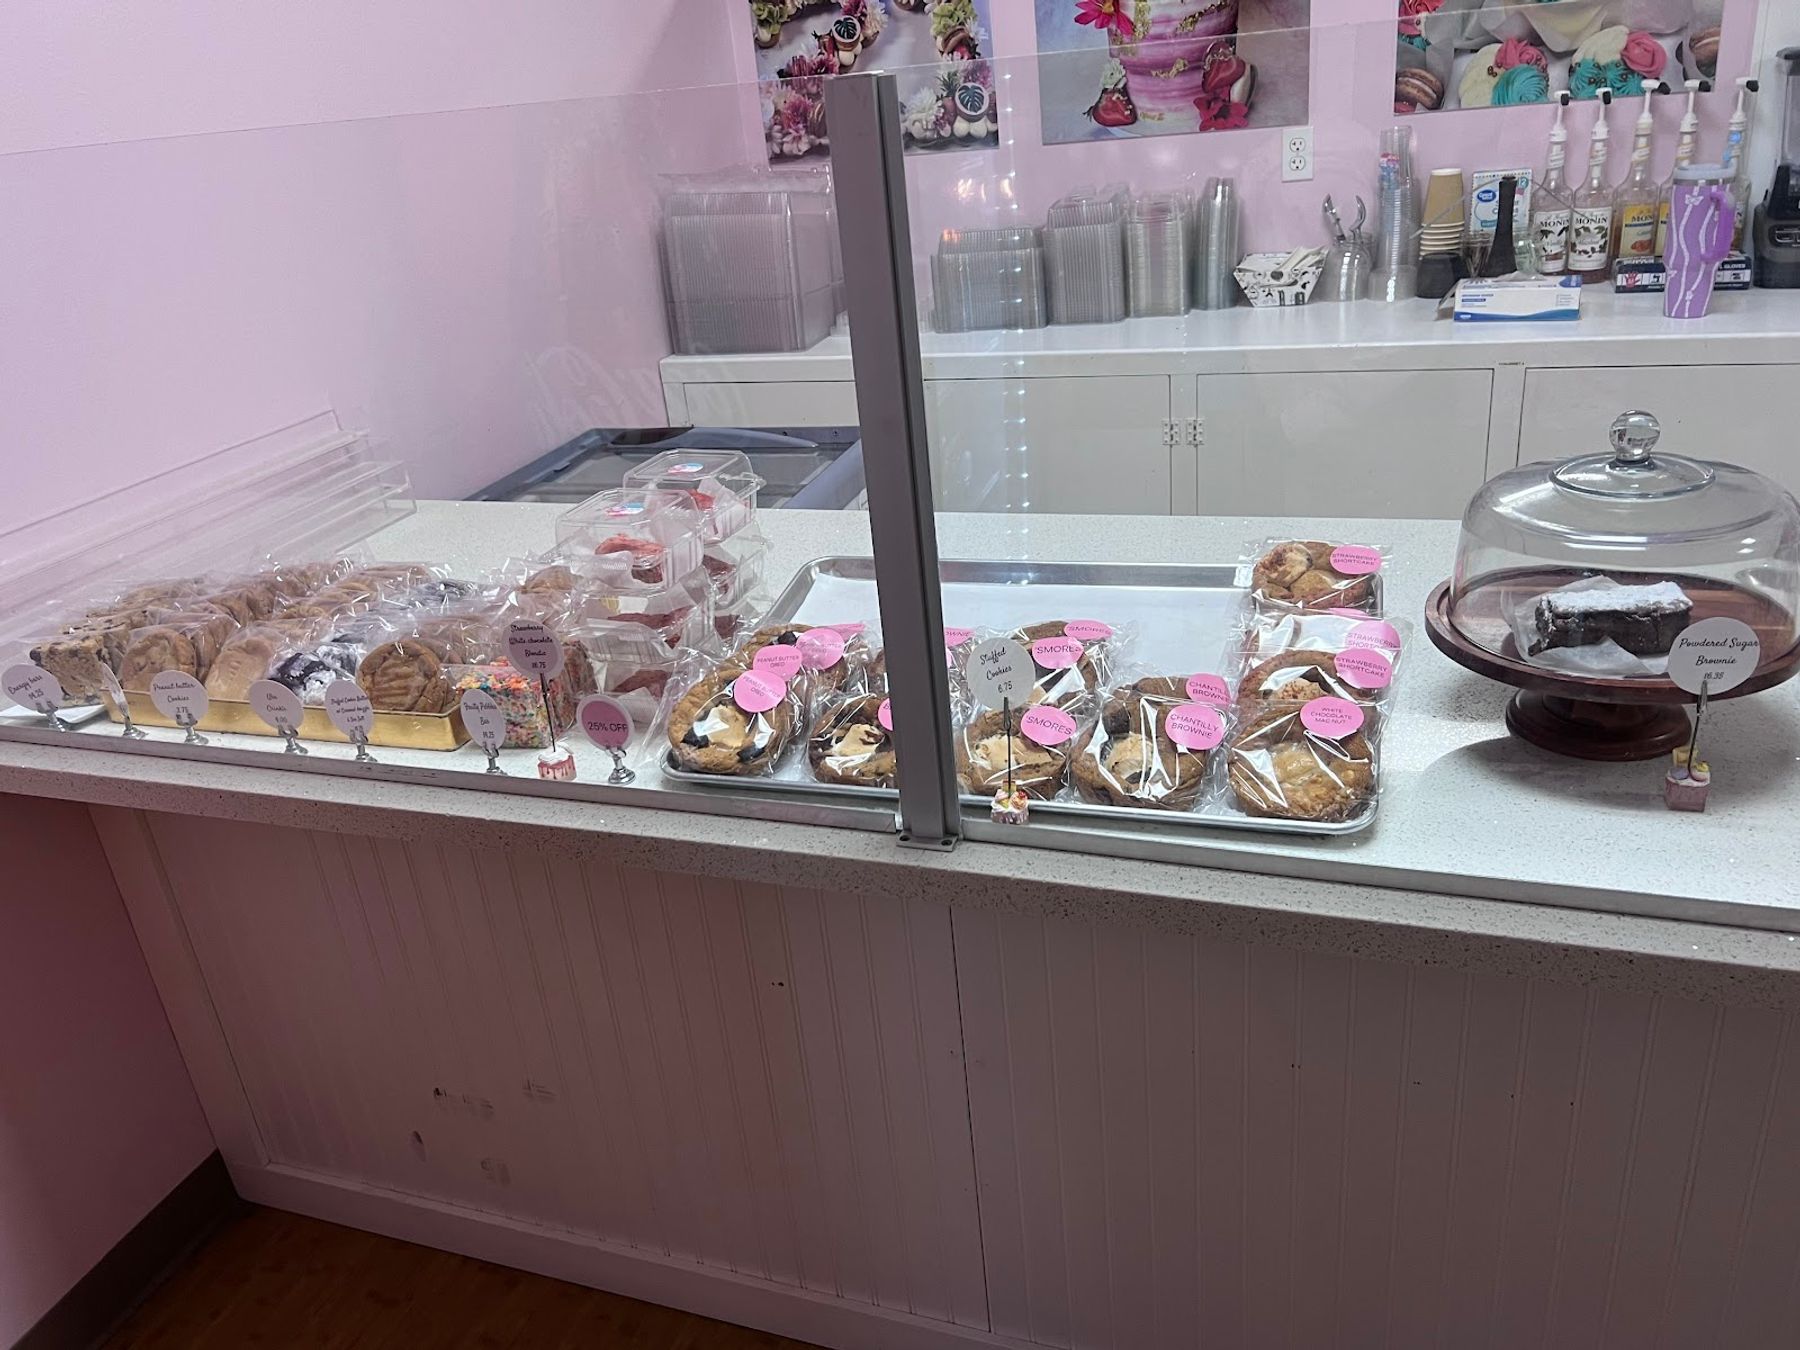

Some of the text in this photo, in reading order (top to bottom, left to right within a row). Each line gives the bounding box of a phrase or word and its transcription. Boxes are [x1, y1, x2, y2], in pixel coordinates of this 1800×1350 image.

[1575, 216, 1608, 225] MONIN
[1332, 553, 1377, 561] STRAWBERRY
[1679, 637, 1760, 652] Powdered Sugar
[979, 646, 1007, 666] Stuffed
[1695, 655, 1737, 666] Brownie
[1336, 657, 1388, 672] STRAWBERRY
[1338, 663, 1385, 678] SHORTCAKE
[986, 665, 1013, 681] Cookies
[8, 682, 32, 695] Energy
[152, 682, 176, 692] Peanut
[1170, 713, 1219, 732] CHANTILLY
[1310, 711, 1353, 720] CHOCOLATE
[587, 721, 628, 733] 25% OFF
[1171, 722, 1213, 739] BROWNIE
